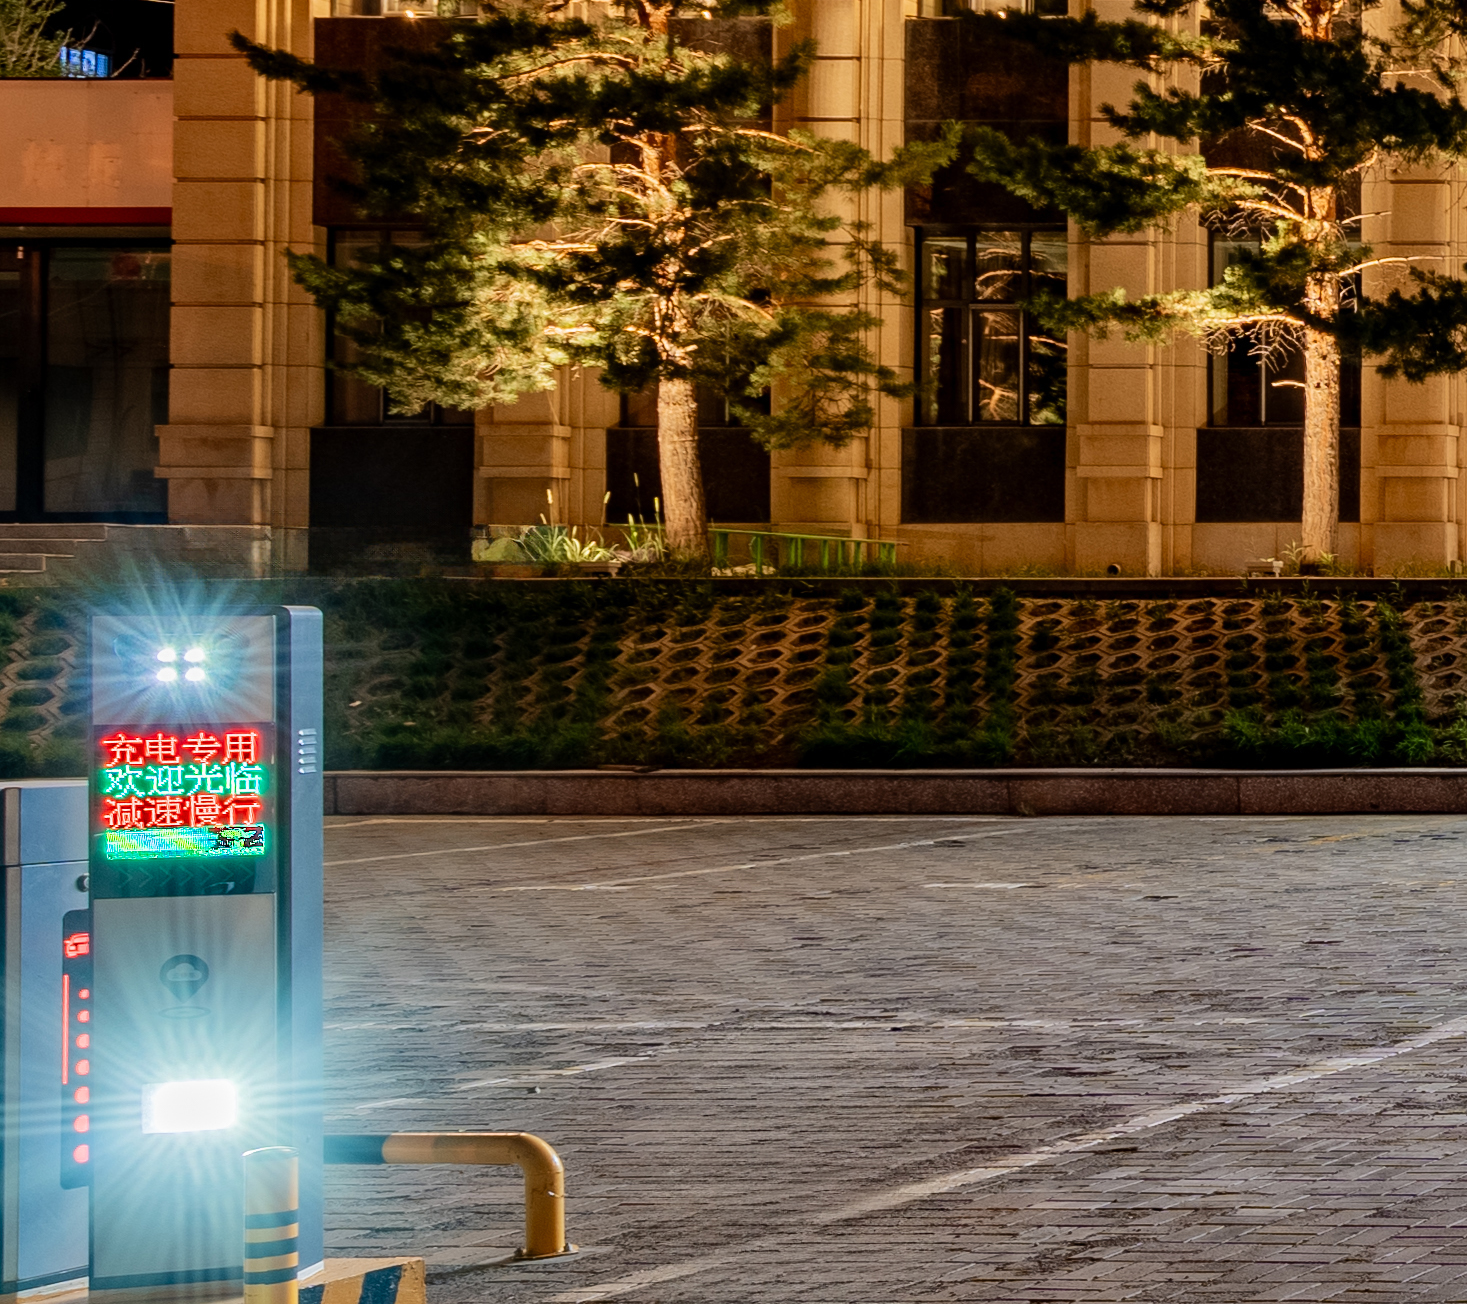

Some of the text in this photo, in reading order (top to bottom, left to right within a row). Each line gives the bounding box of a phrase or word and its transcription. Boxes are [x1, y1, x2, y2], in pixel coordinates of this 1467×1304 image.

[103, 732, 259, 766] 充电专用
[105, 762, 263, 797] 欢迎光临
[104, 794, 261, 829] 减速慢行
